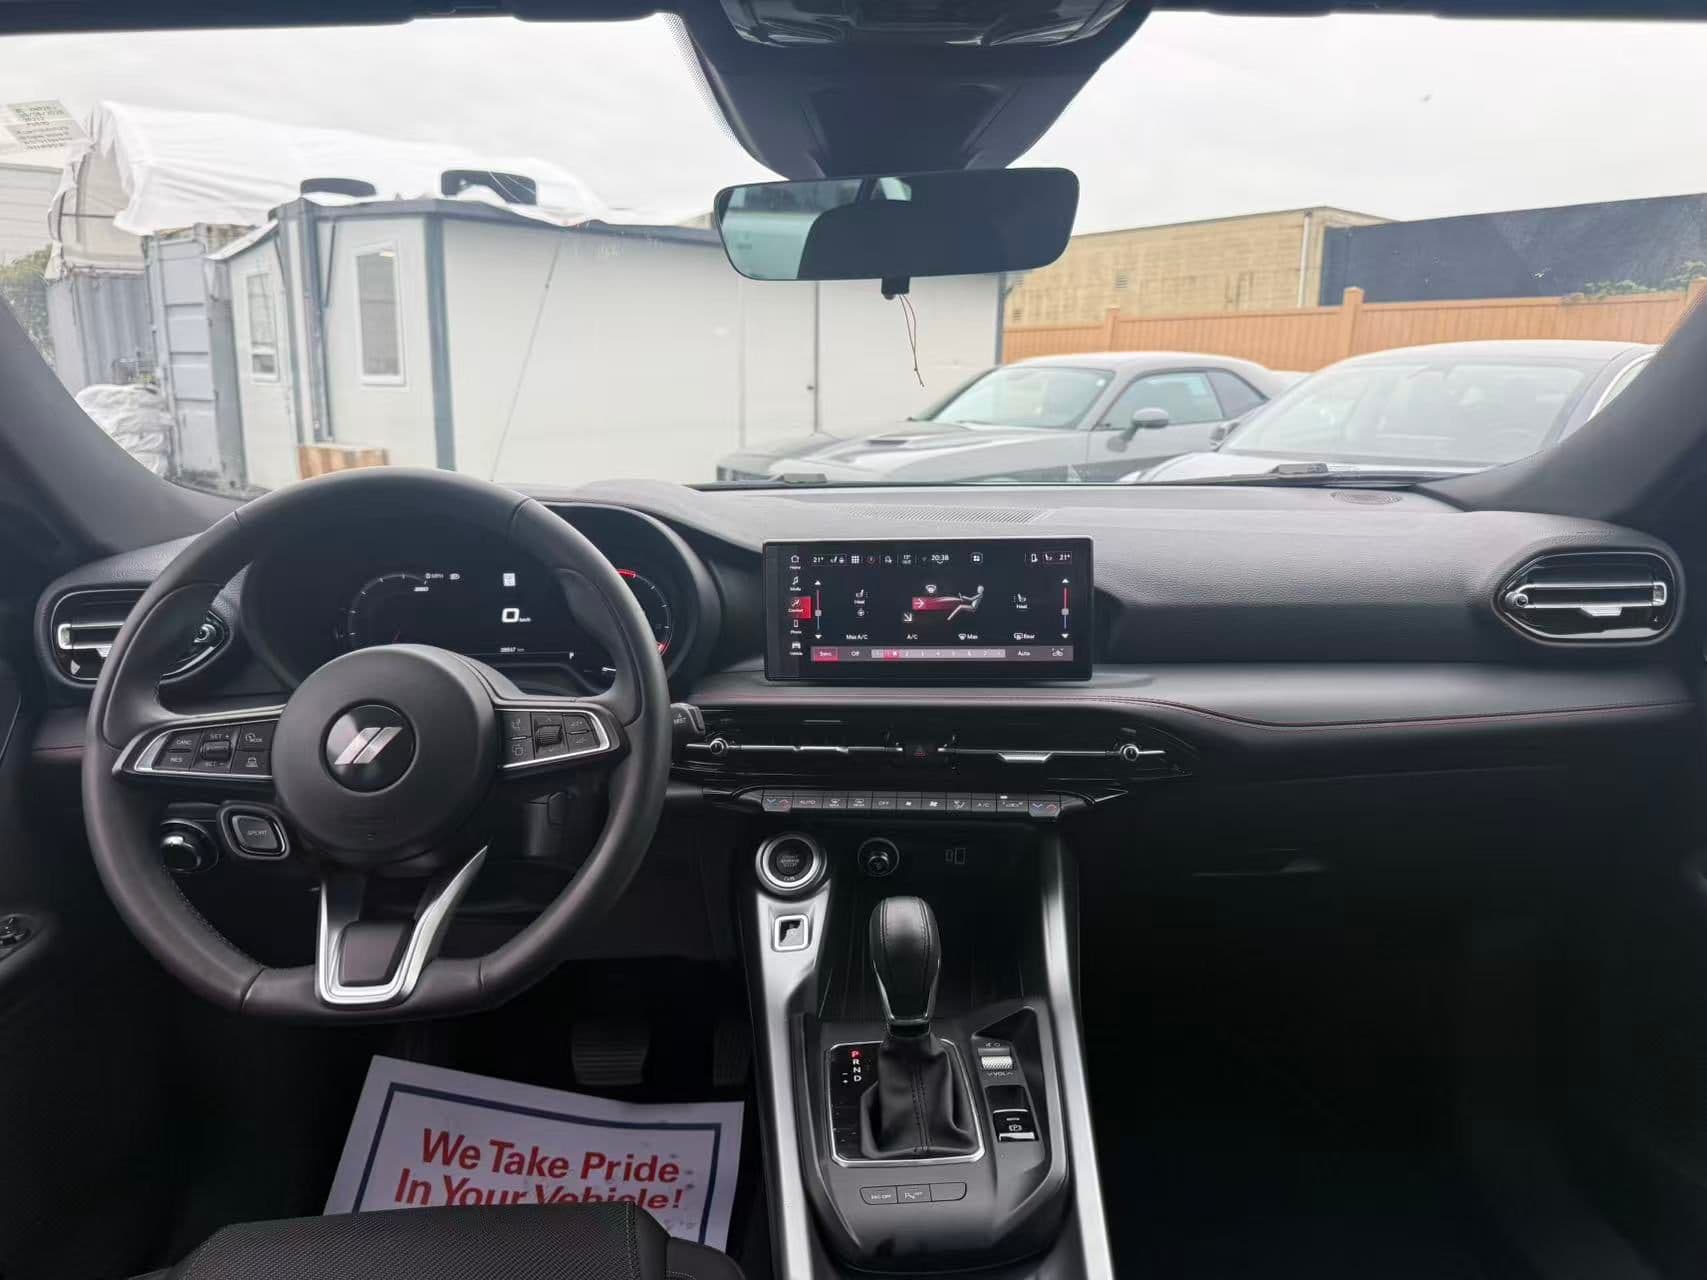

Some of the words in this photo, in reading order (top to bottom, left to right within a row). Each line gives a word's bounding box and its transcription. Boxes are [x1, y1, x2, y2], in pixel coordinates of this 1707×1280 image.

[851, 1050, 860, 1058] P
[853, 1074, 862, 1082] D
[421, 1127, 481, 1170] We
[488, 1138, 569, 1179] Take
[580, 1151, 680, 1184] Pride
[394, 1167, 432, 1206] In
[442, 1174, 528, 1207] Your
